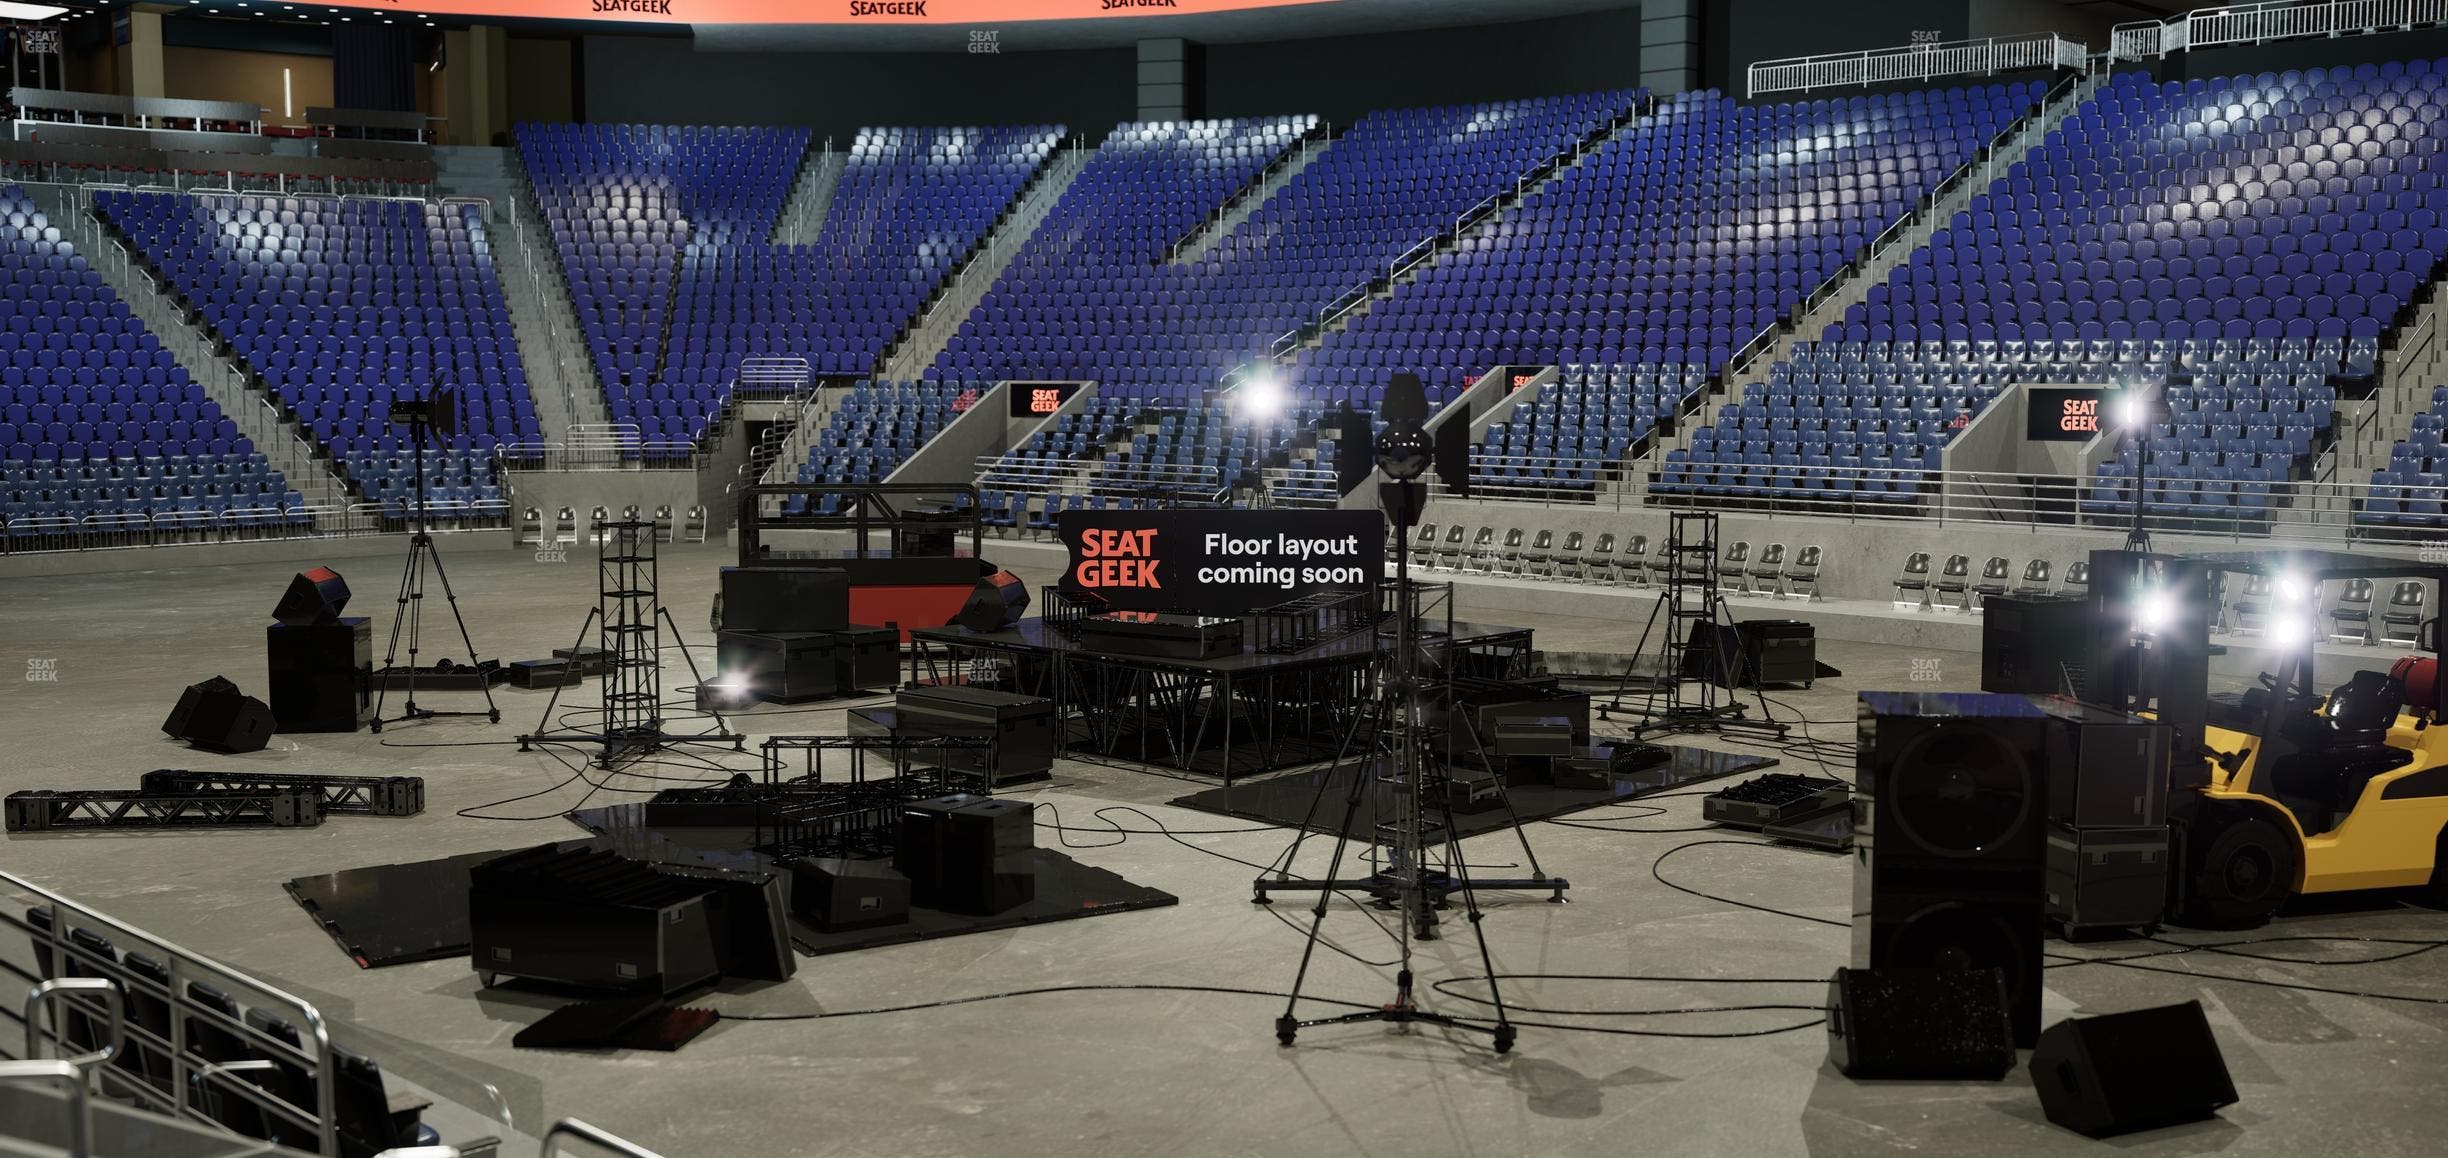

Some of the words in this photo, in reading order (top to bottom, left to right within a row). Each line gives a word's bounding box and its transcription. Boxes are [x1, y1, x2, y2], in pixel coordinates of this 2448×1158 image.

[593, 0, 672, 15] SEATGEEK
[850, 1, 927, 16] SEATGEEK
[1032, 388, 1060, 401] SEAT
[1031, 400, 1060, 413] GEEK
[2063, 399, 2098, 415] SEAT
[2060, 415, 2099, 432] GEEK
[1082, 528, 1160, 558] SEAT
[1205, 533, 1272, 555] Floor
[1278, 533, 1358, 561] layout
[1077, 559, 1162, 589] GEEK
[1198, 561, 1295, 589] coming
[1303, 567, 1364, 584] soon
